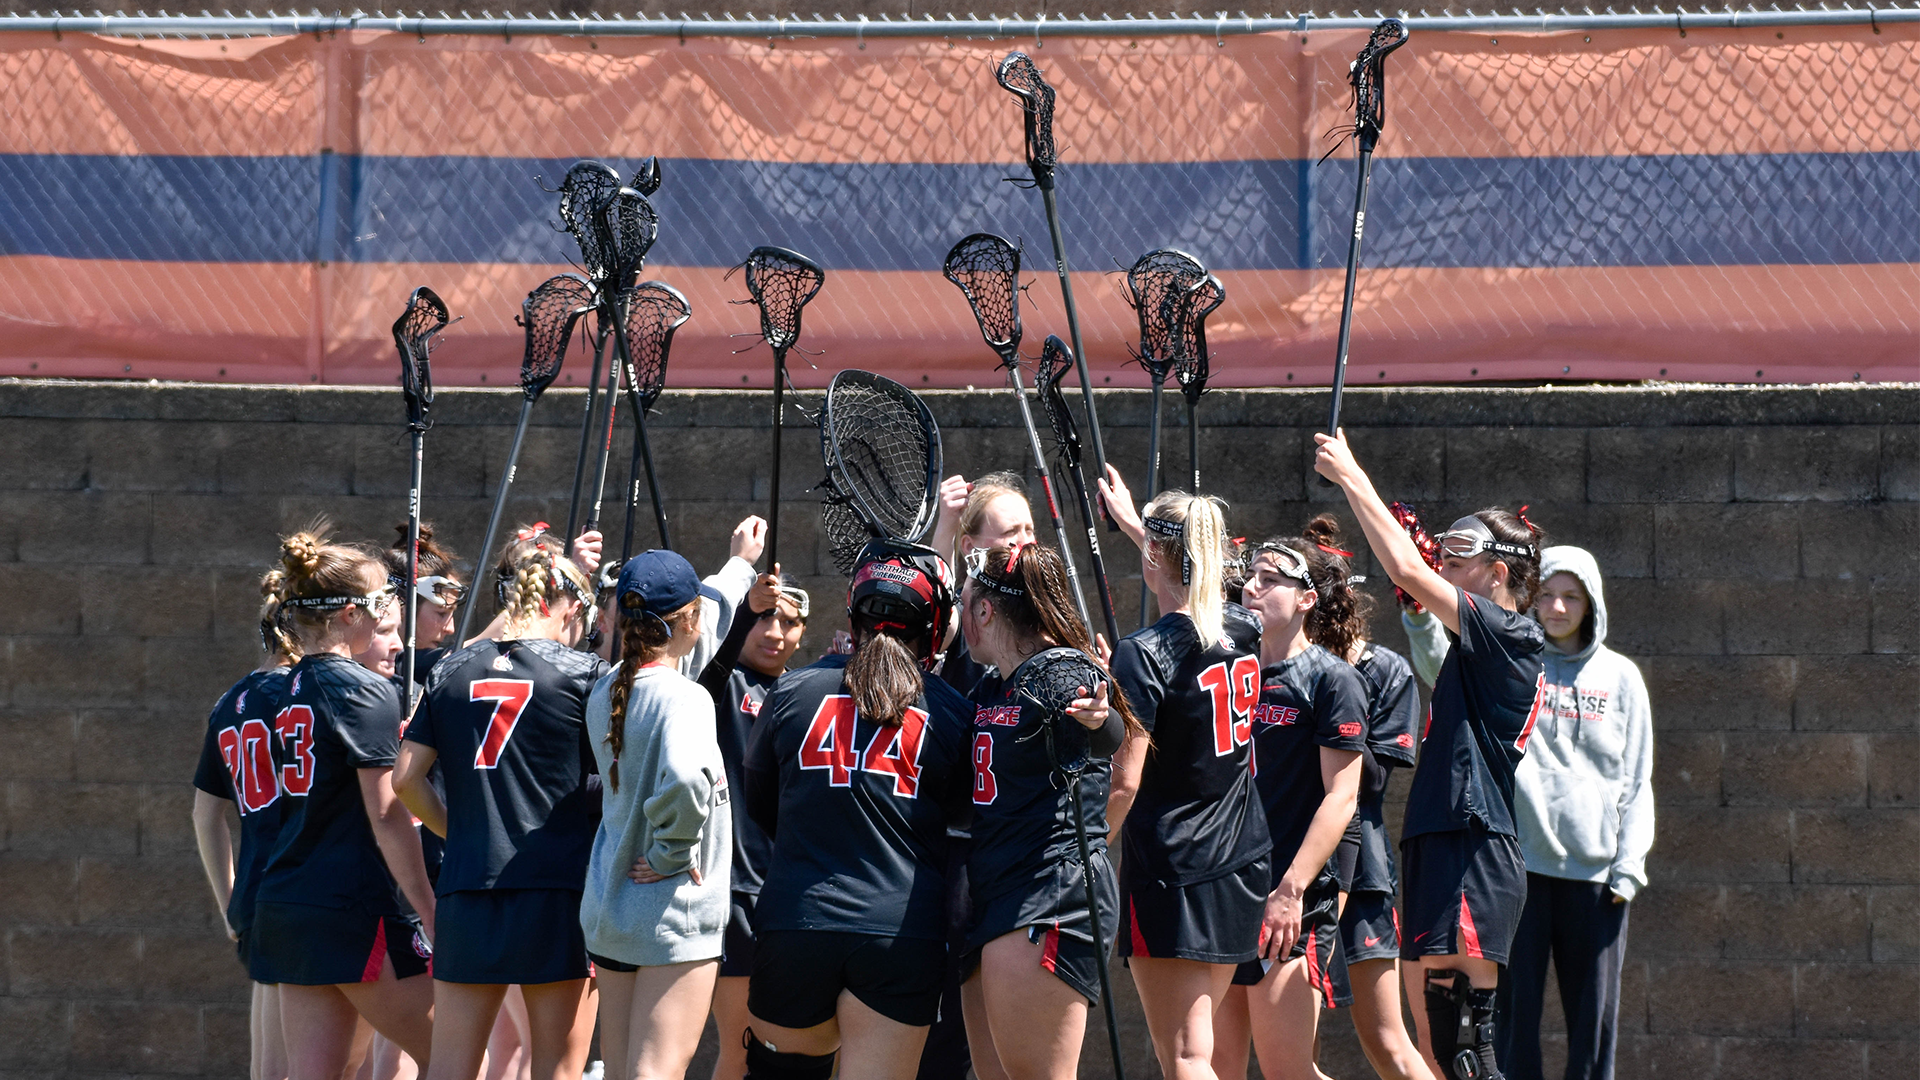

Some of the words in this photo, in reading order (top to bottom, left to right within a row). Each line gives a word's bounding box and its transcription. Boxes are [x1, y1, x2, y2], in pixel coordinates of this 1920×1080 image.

[1354, 211, 1365, 241] GAIT
[627, 363, 639, 393] GAIT
[1087, 527, 1100, 556] GAIT
[1163, 527, 1182, 537] GAIT
[1495, 543, 1516, 553] GAIT
[870, 562, 919, 579] CARTHAGE
[871, 570, 913, 585] FIREBIRDS
[978, 575, 998, 589] GAIT
[1000, 586, 1024, 596] GAIT
[302, 598, 321, 606] GAIT
[325, 597, 347, 605] GAIT
[351, 597, 371, 606] GAIT
[1196, 653, 1261, 757] 19
[469, 678, 534, 770] 7
[798, 694, 930, 799] 44
